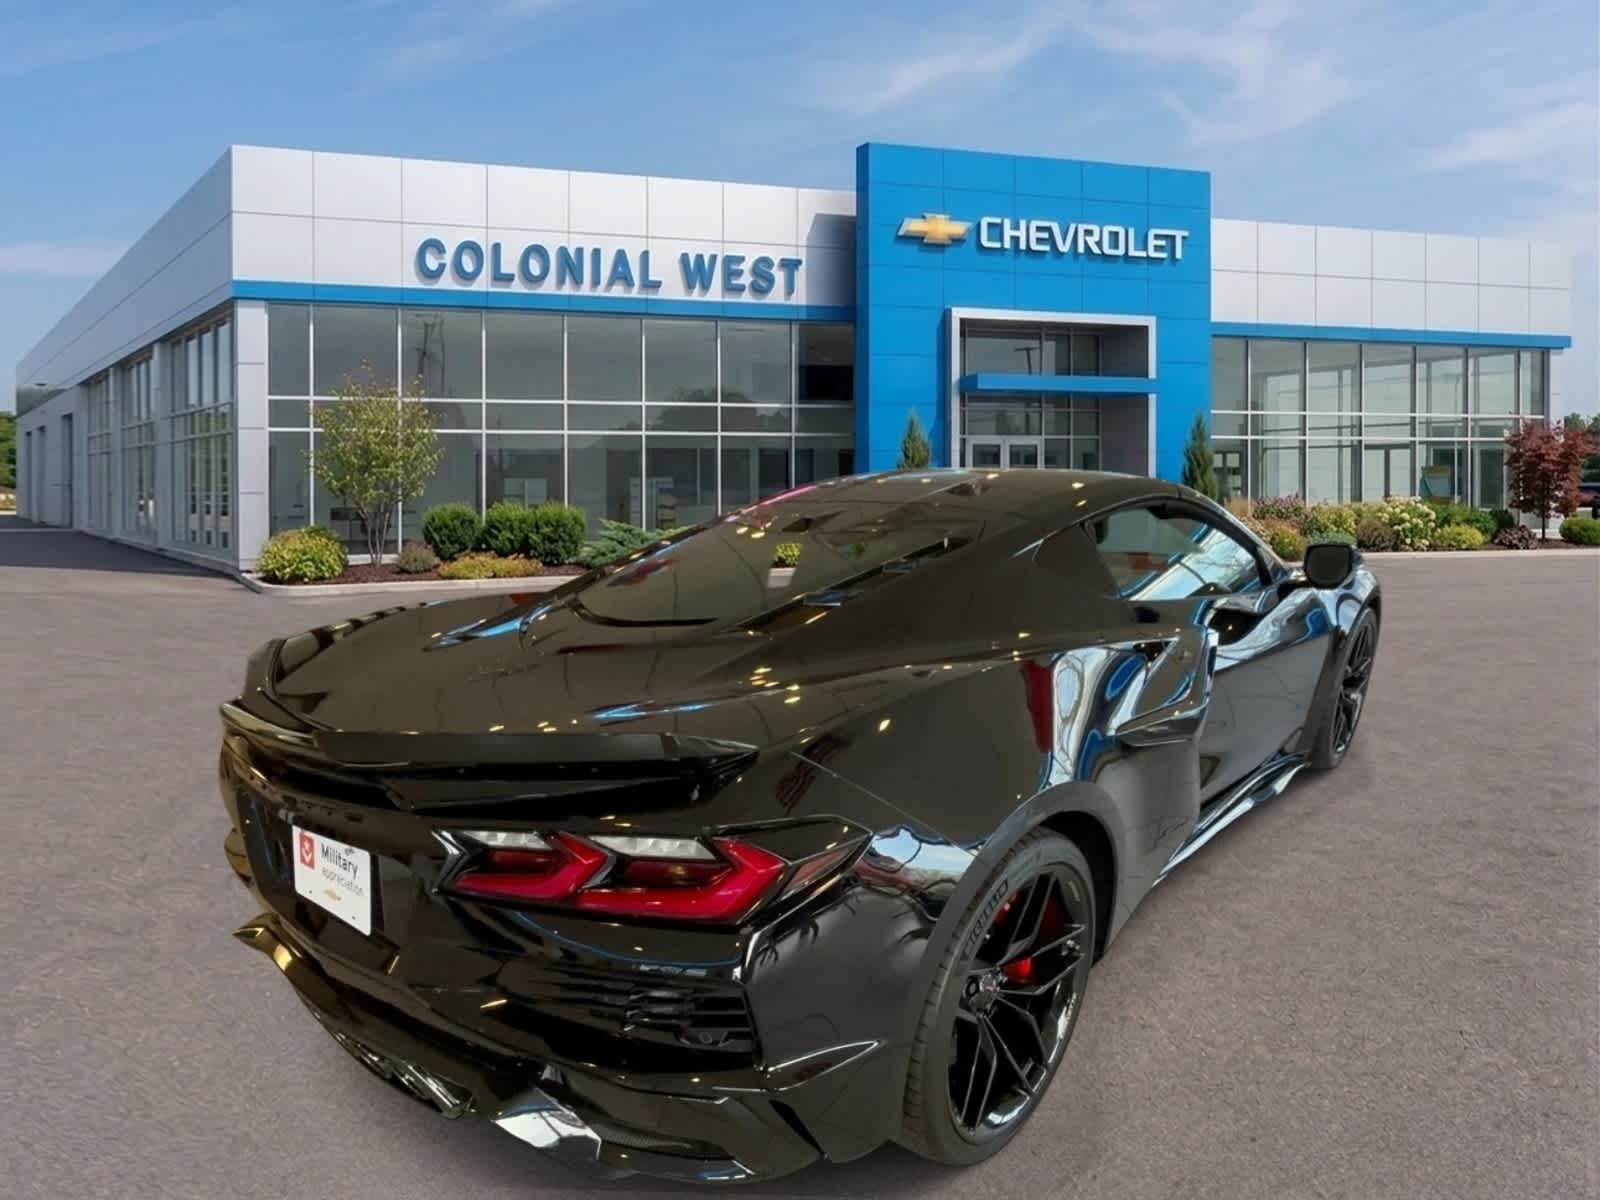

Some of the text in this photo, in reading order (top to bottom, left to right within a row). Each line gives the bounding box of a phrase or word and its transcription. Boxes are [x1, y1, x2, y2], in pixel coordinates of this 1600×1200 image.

[979, 217, 1189, 260] CHEVROLET
[415, 238, 803, 297] COLONIAL WEST
[321, 843, 358, 881] Military
